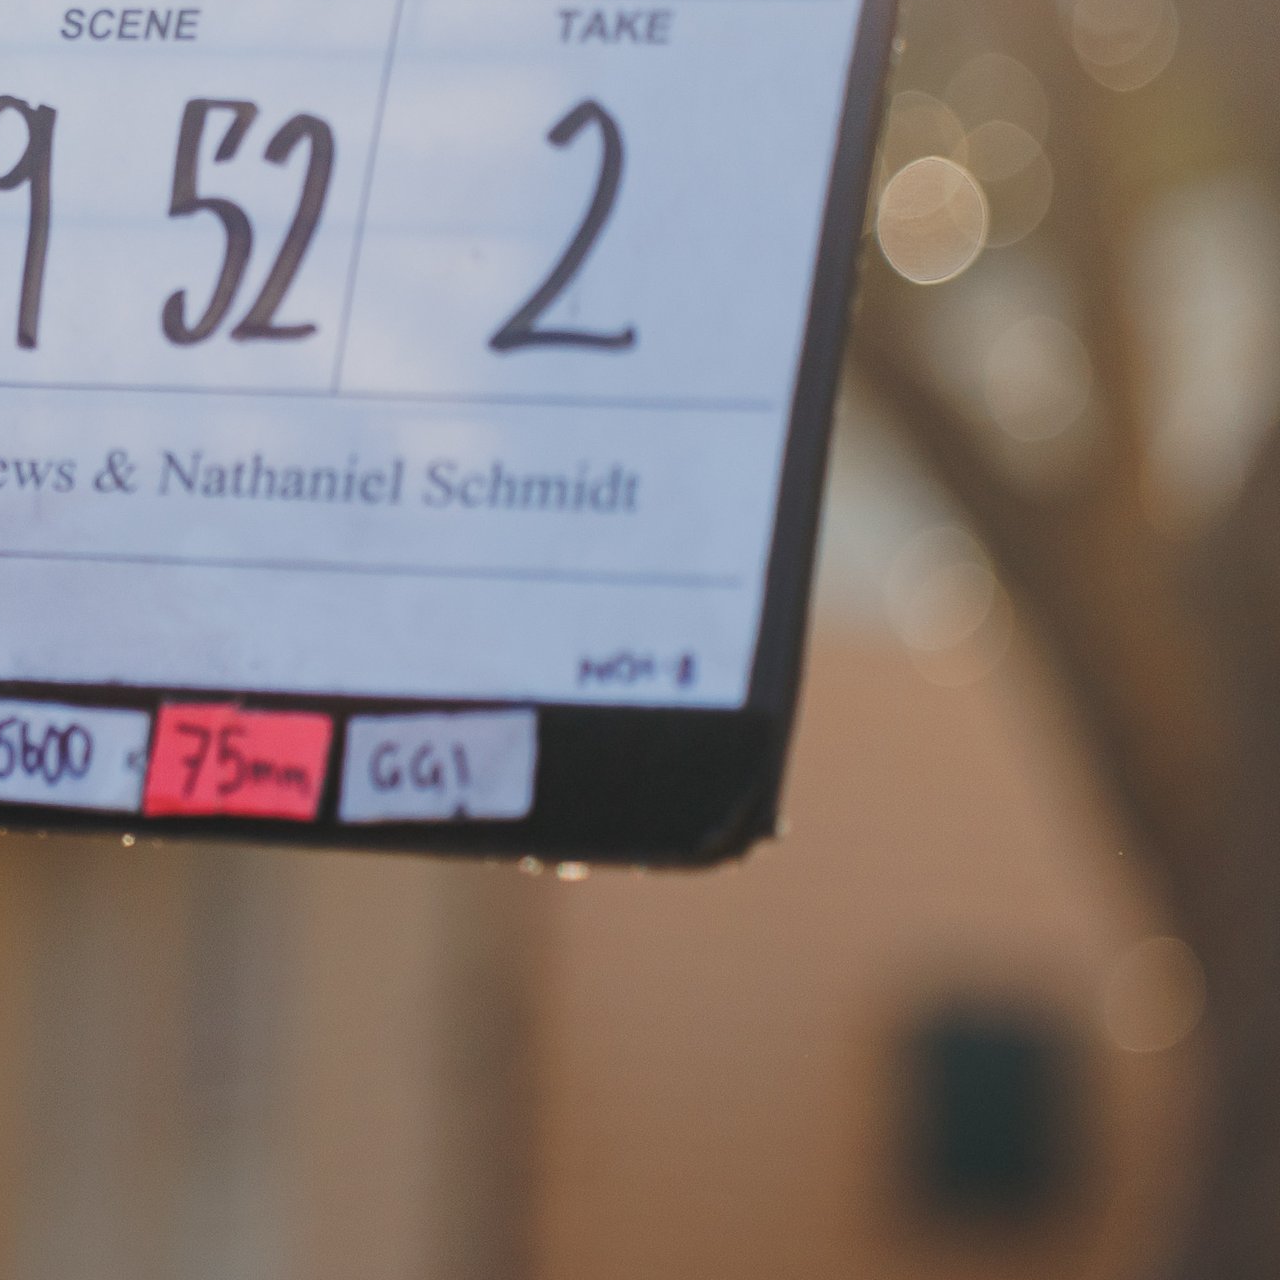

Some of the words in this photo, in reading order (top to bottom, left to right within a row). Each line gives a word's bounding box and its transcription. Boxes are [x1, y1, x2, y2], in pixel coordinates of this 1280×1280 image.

[59, 8, 202, 42] SCENE
[557, 8, 675, 45] TAKE
[161, 97, 336, 347] 52
[486, 98, 637, 355] 2
[91, 451, 140, 495] &
[158, 451, 403, 506] Nathaniel
[421, 461, 642, 515] Schmidt
